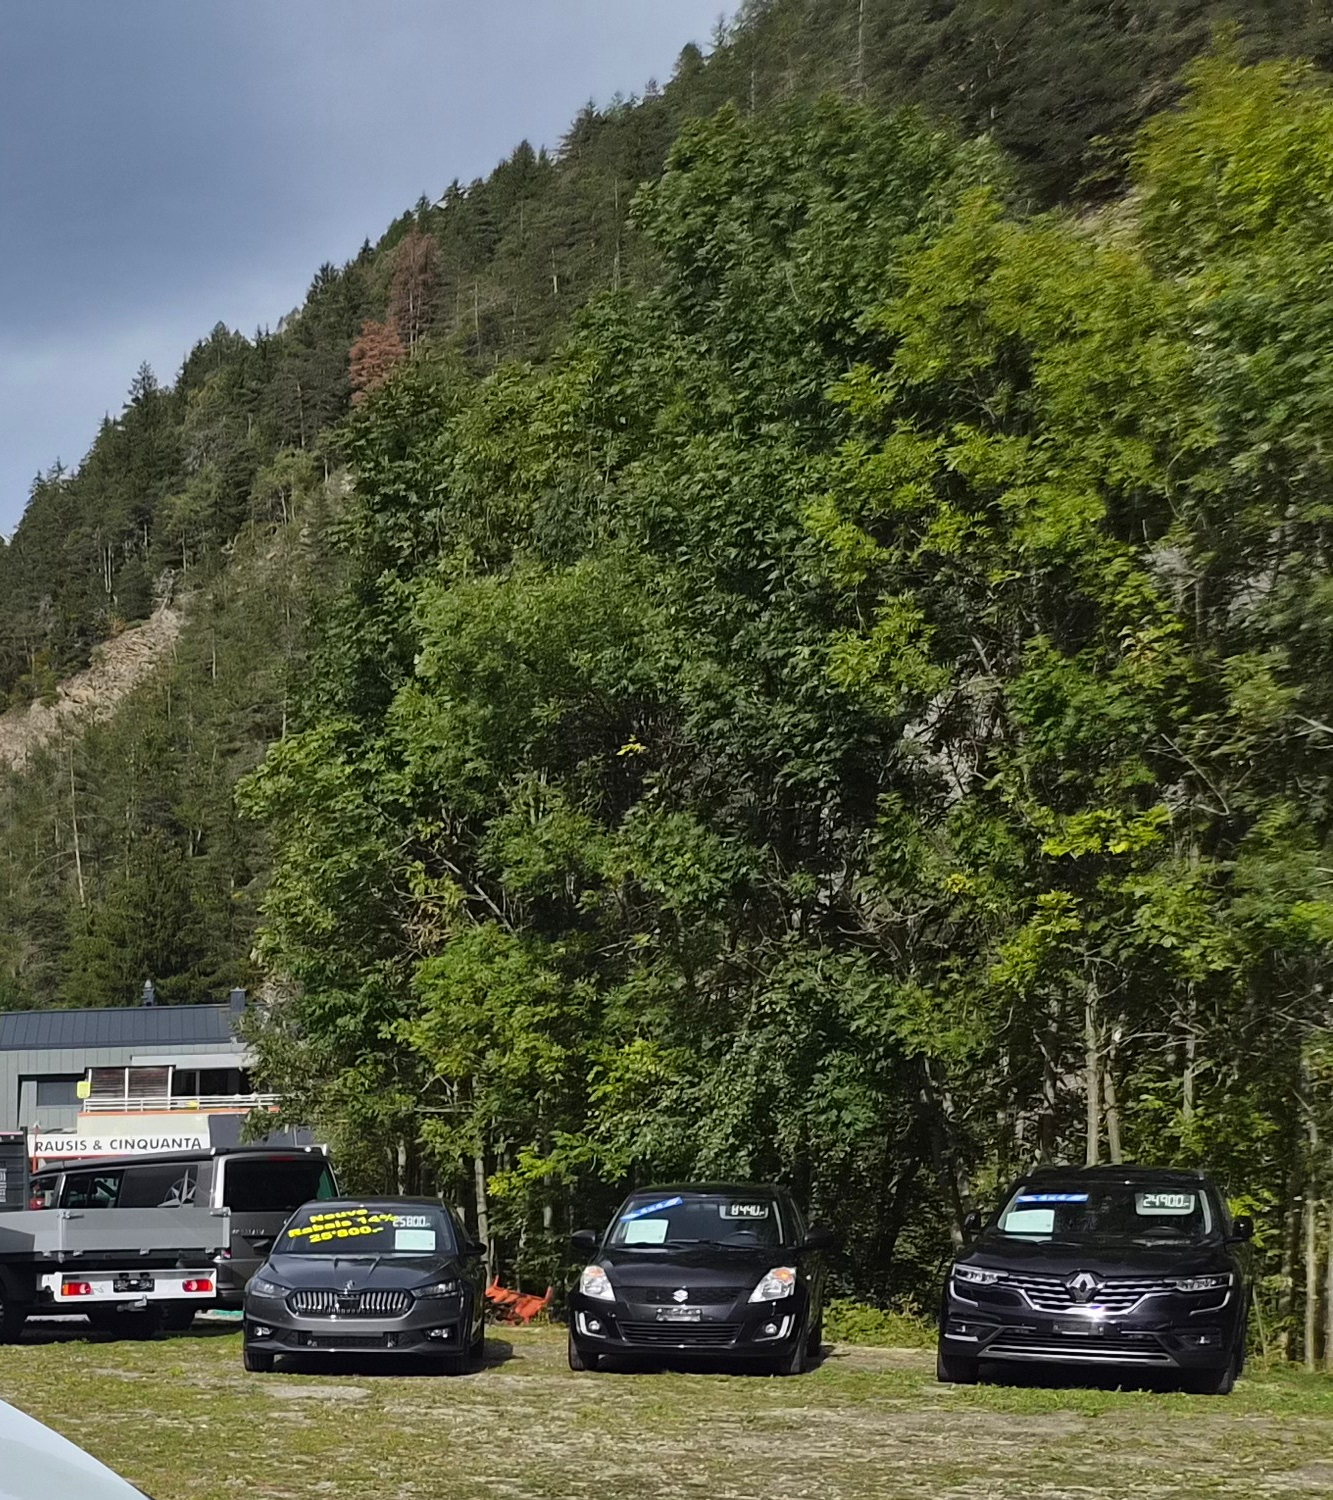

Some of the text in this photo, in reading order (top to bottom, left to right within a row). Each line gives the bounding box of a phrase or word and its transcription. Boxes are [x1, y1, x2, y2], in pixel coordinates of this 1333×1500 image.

[35, 1137, 202, 1153] RAUSIS & CINQUANTA
[288, 1220, 352, 1238] Rabais
